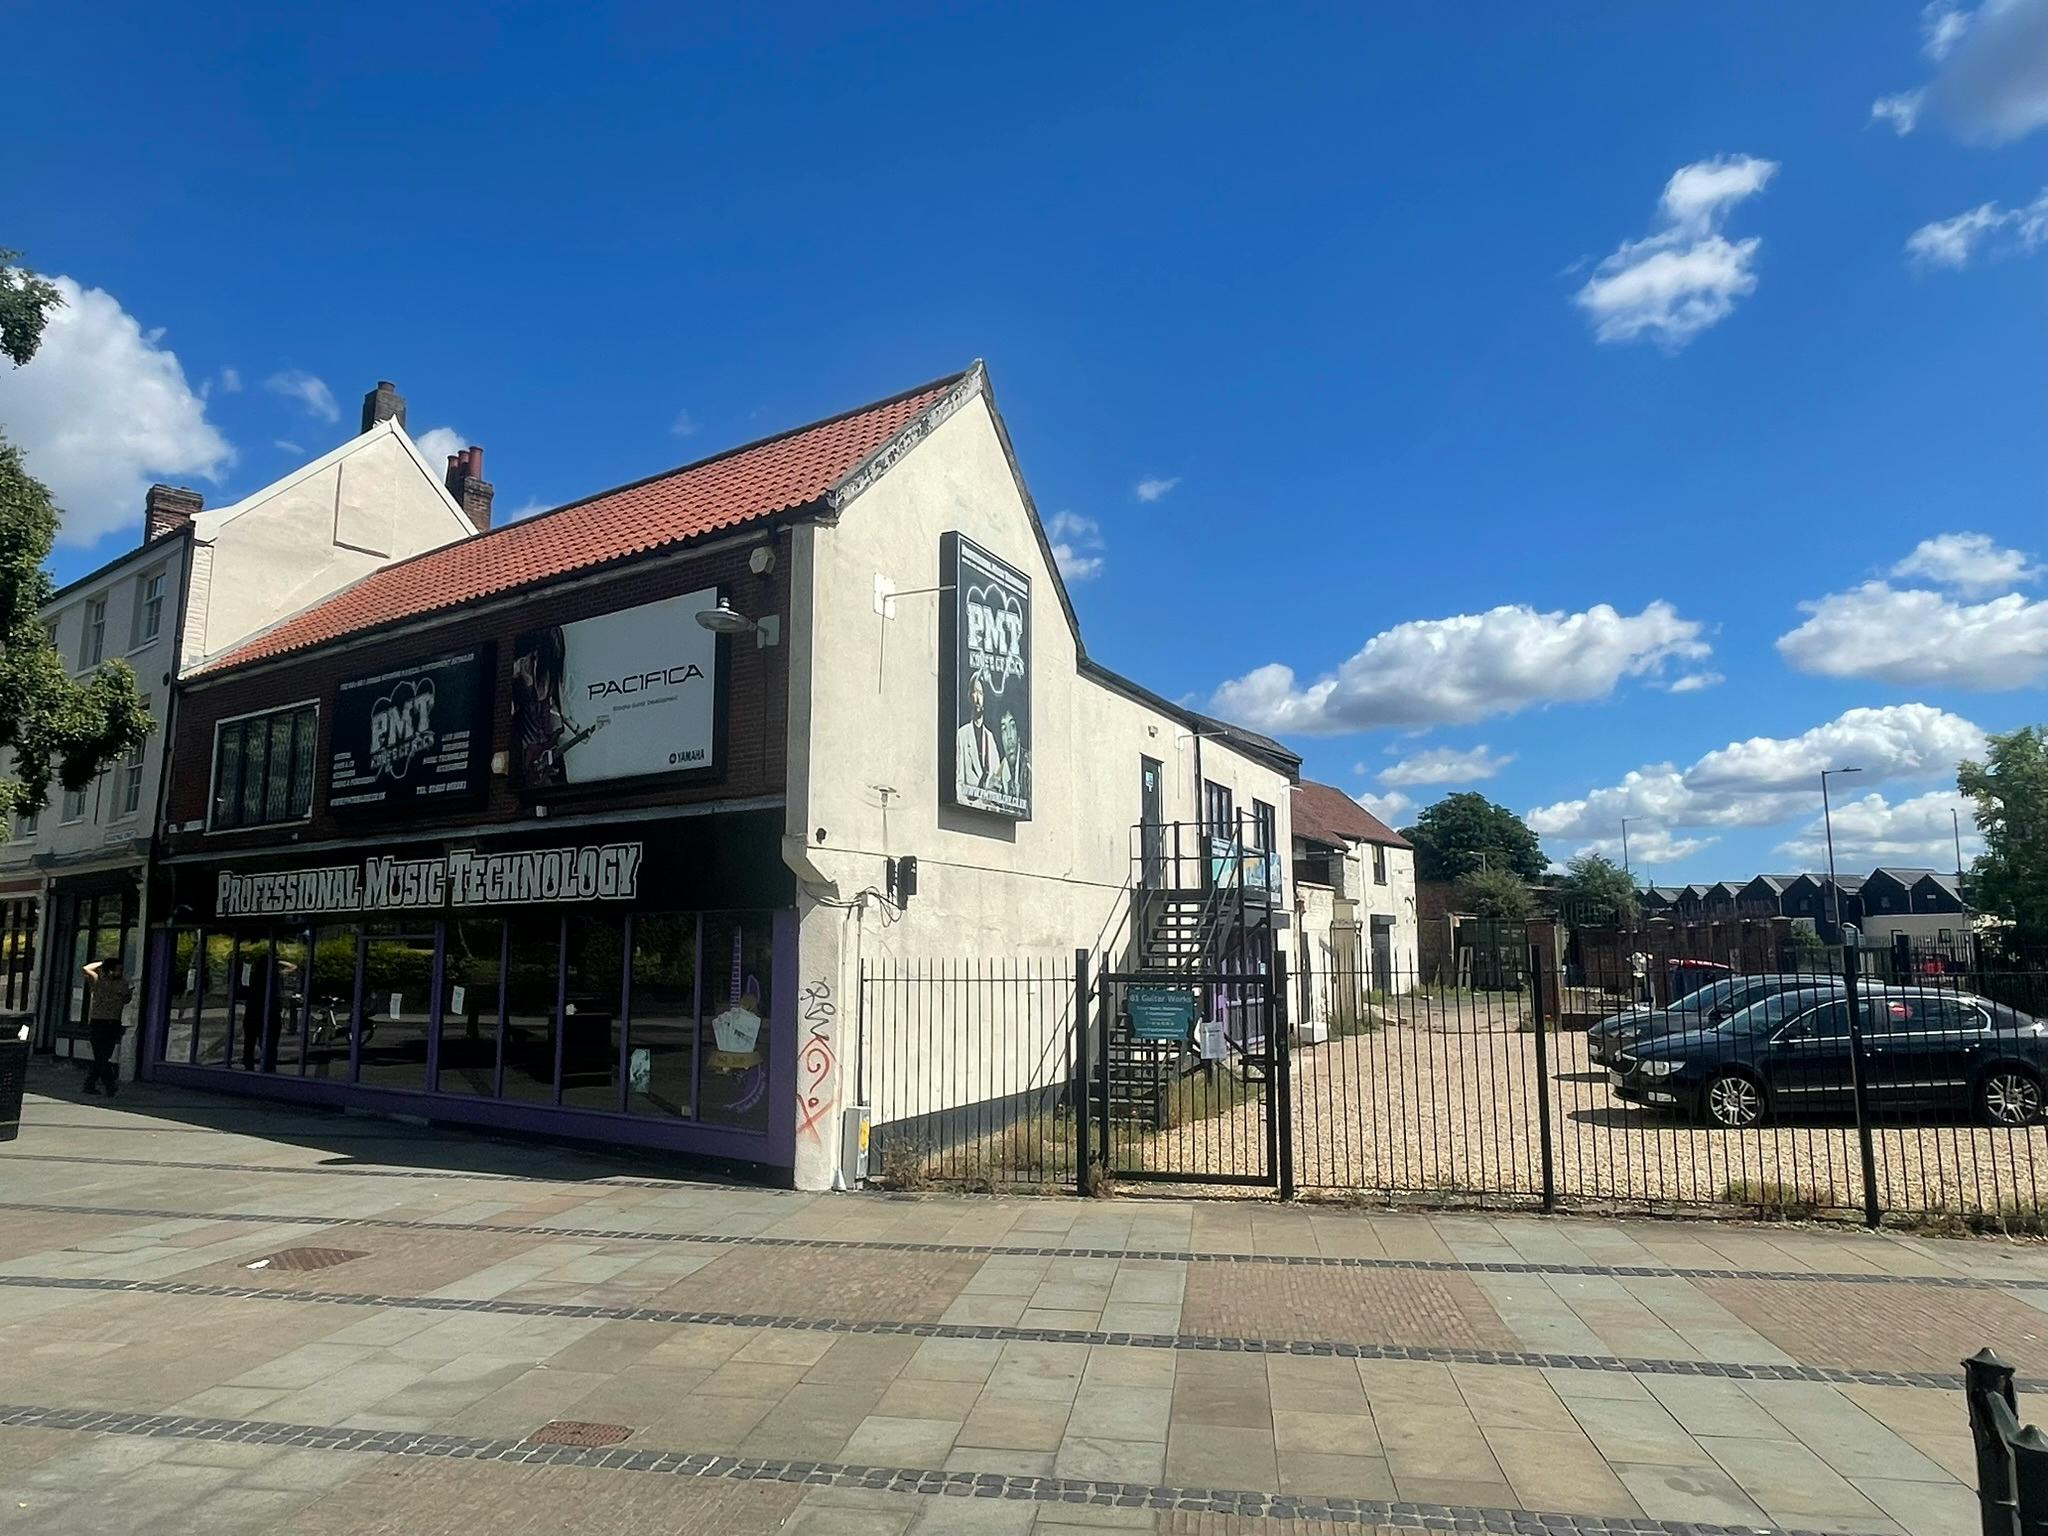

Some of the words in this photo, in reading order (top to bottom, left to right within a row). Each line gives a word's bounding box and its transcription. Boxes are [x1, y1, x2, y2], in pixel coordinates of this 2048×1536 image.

[966, 602, 1023, 656] PMT
[588, 664, 704, 700] PACIFICA
[370, 692, 435, 754] PMT
[216, 866, 362, 917] PROFESSIONAL
[364, 855, 448, 911] MUSIC
[448, 842, 642, 907] TECHNOLOGY
